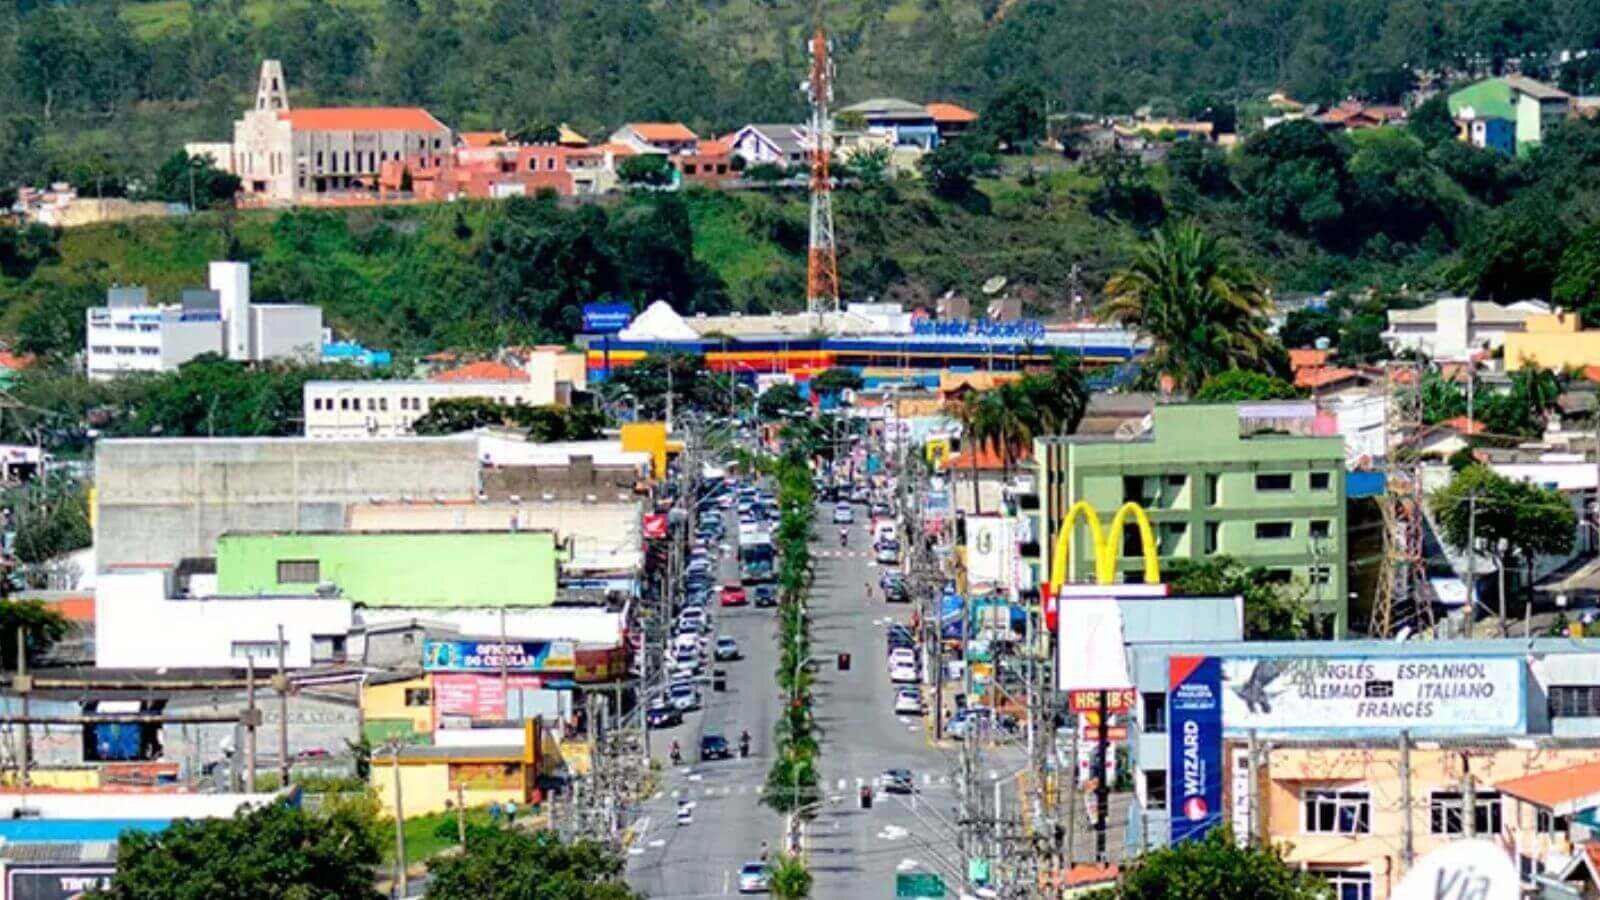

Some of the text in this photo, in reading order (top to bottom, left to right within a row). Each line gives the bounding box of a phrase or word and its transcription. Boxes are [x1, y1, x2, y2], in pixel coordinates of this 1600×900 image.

[1397, 662, 1486, 679] ESPANHOL
[1417, 682, 1495, 699] ITALIANO
[1183, 720, 1199, 796] WIZARD
